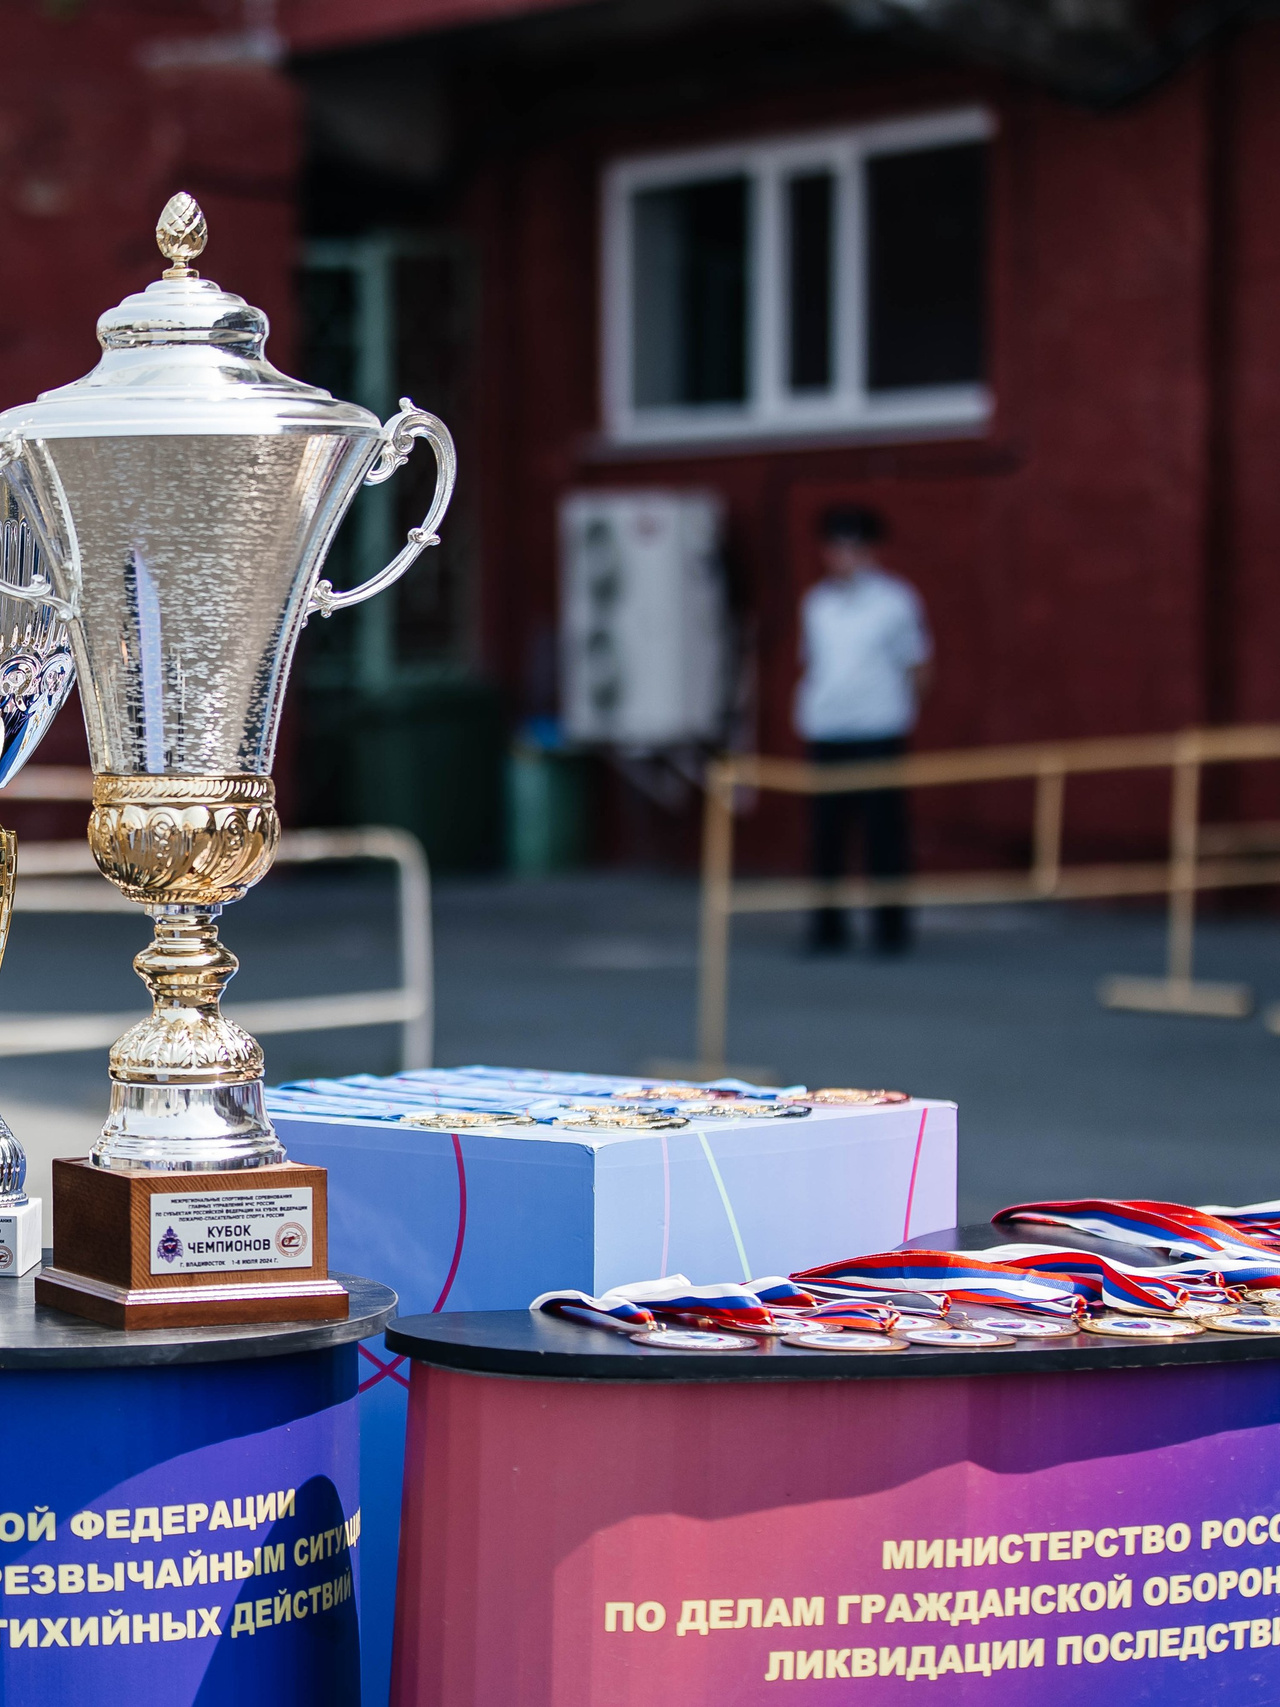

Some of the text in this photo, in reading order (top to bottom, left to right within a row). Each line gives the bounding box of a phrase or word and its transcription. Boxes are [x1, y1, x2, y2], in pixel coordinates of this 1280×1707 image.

[188, 1239, 271, 1254] ЧЕМПИОНОВ
[207, 1225, 251, 1238] КУБОК
[71, 1489, 296, 1541] ФЕДЕРАЦИИ
[882, 1523, 1191, 1569] МИНИСТЕРСТВО
[230, 1568, 352, 1637] ДЕЙСТВИЙ
[605, 1601, 666, 1631] ПО
[676, 1597, 824, 1636] ДЕЛАМ
[838, 1574, 1132, 1626] ГРАЖДАНСКОЙ
[765, 1638, 1044, 1681] ЛИКВИДАЦИИ
